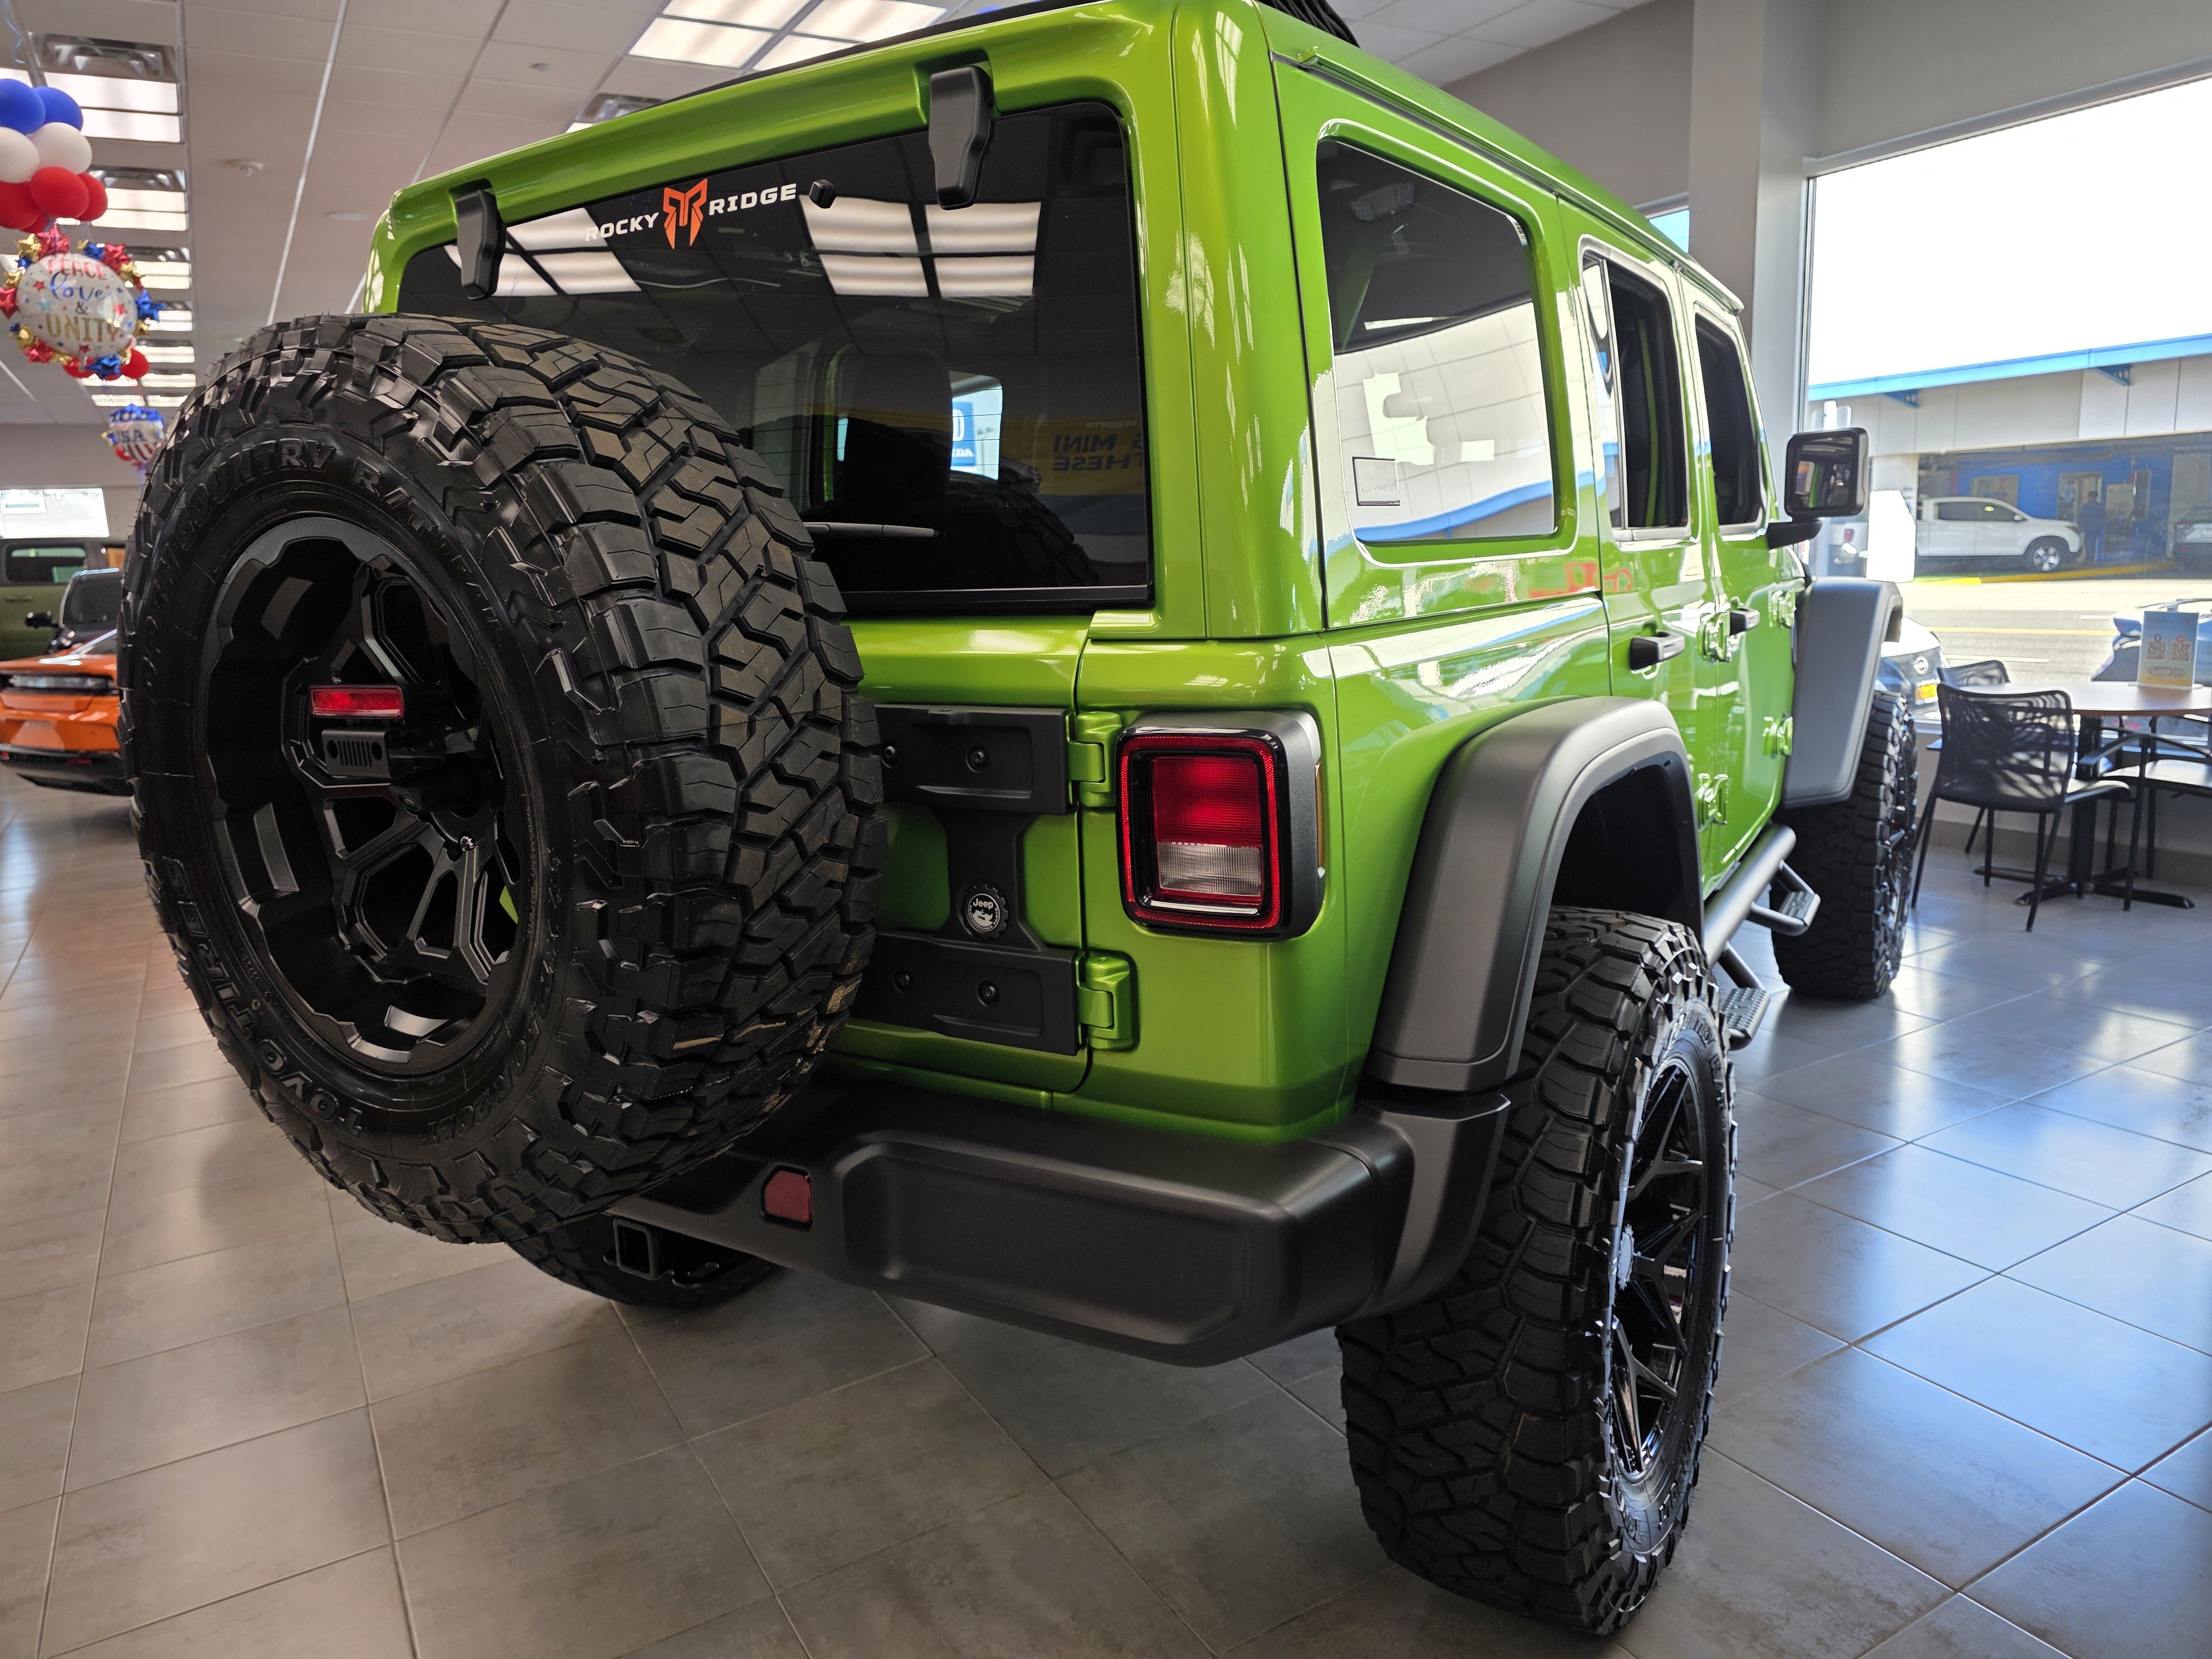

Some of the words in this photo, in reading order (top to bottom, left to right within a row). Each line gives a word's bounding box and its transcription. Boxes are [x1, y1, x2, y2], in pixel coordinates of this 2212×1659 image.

[585, 212, 659, 242] ROCKY
[708, 183, 797, 216] RIDGE
[46, 312, 119, 343] UNITY
[973, 898, 994, 910] Jeep
[257, 1037, 364, 1138] TOYO
